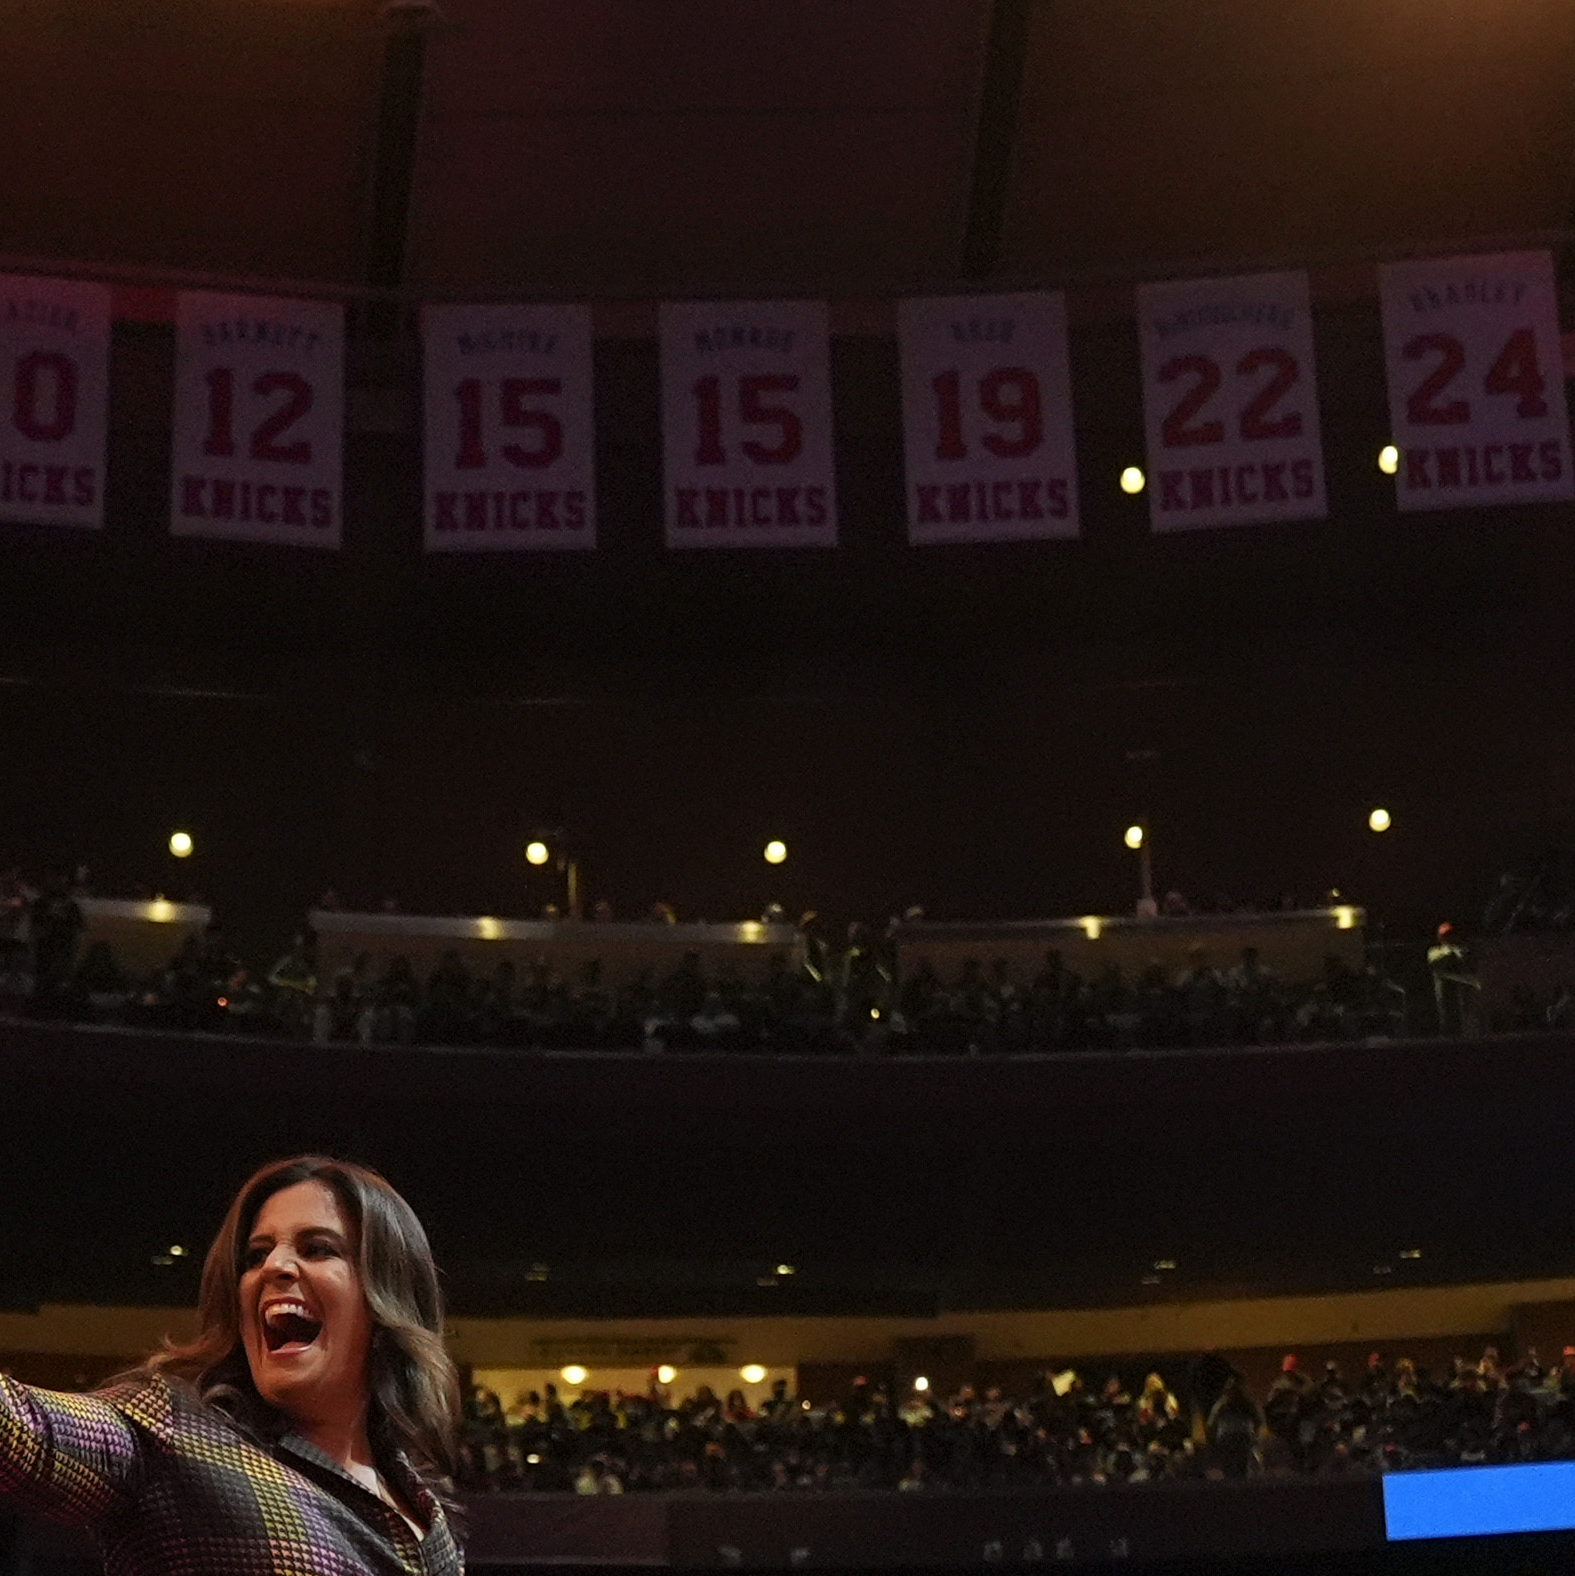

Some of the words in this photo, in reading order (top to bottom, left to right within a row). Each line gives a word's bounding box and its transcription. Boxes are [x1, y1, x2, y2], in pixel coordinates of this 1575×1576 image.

[1156, 347, 1304, 448] 22
[1403, 327, 1547, 425] 24
[204, 367, 314, 464] 12
[454, 376, 563, 469] 15
[693, 374, 802, 465] 15
[932, 366, 1045, 461] 19
[916, 478, 1068, 523] KNICKS
[1159, 459, 1314, 511] KNICKS
[1405, 441, 1562, 490] KNICKS
[181, 477, 333, 528] KNICKS
[434, 490, 587, 531] KNICKS
[675, 486, 827, 527] KNICKS
